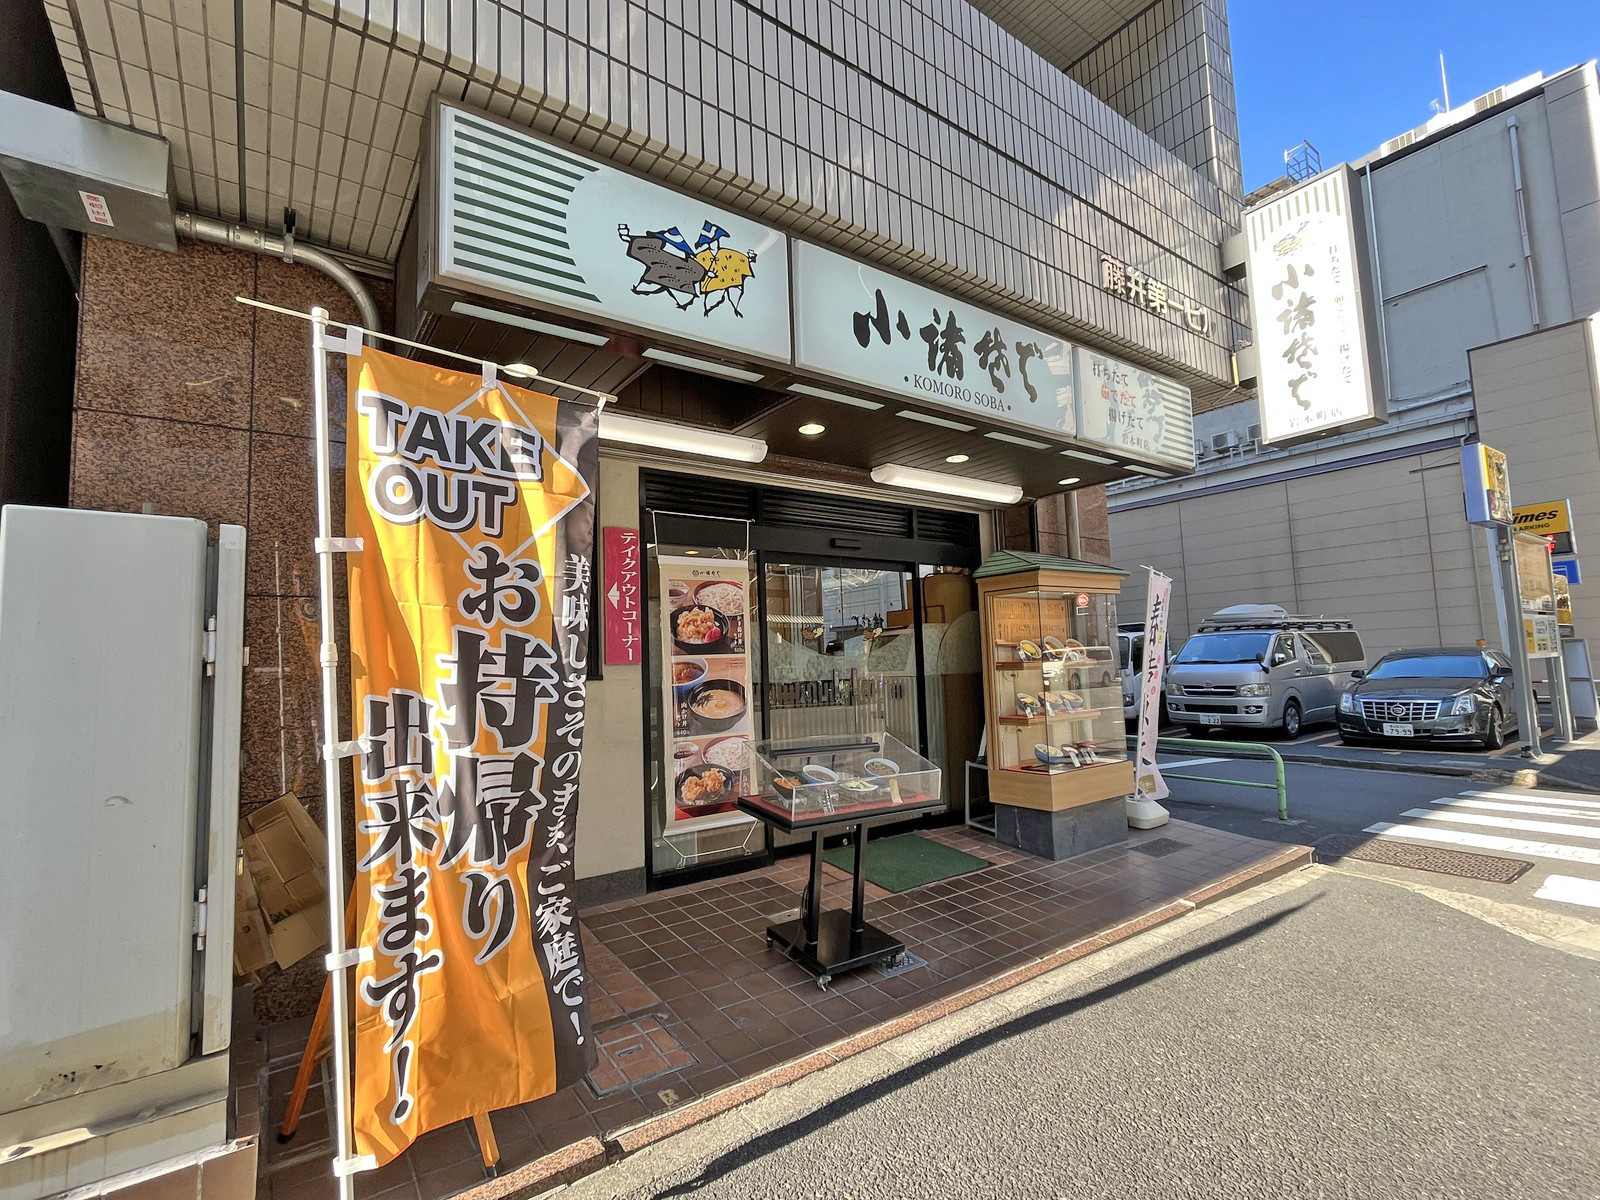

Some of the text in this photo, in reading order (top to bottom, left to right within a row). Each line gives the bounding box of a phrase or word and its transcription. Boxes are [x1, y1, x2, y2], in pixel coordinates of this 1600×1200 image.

[1092, 361, 1128, 386] 打ちたて
[913, 373, 1005, 412] KOMORO SOBA
[1101, 384, 1136, 408] 茹でたて
[1108, 407, 1144, 430] 揚げたて
[358, 390, 544, 482] TAKE
[369, 459, 518, 537] OUT
[1512, 509, 1559, 525] imes
[436, 545, 560, 964] お持帰り
